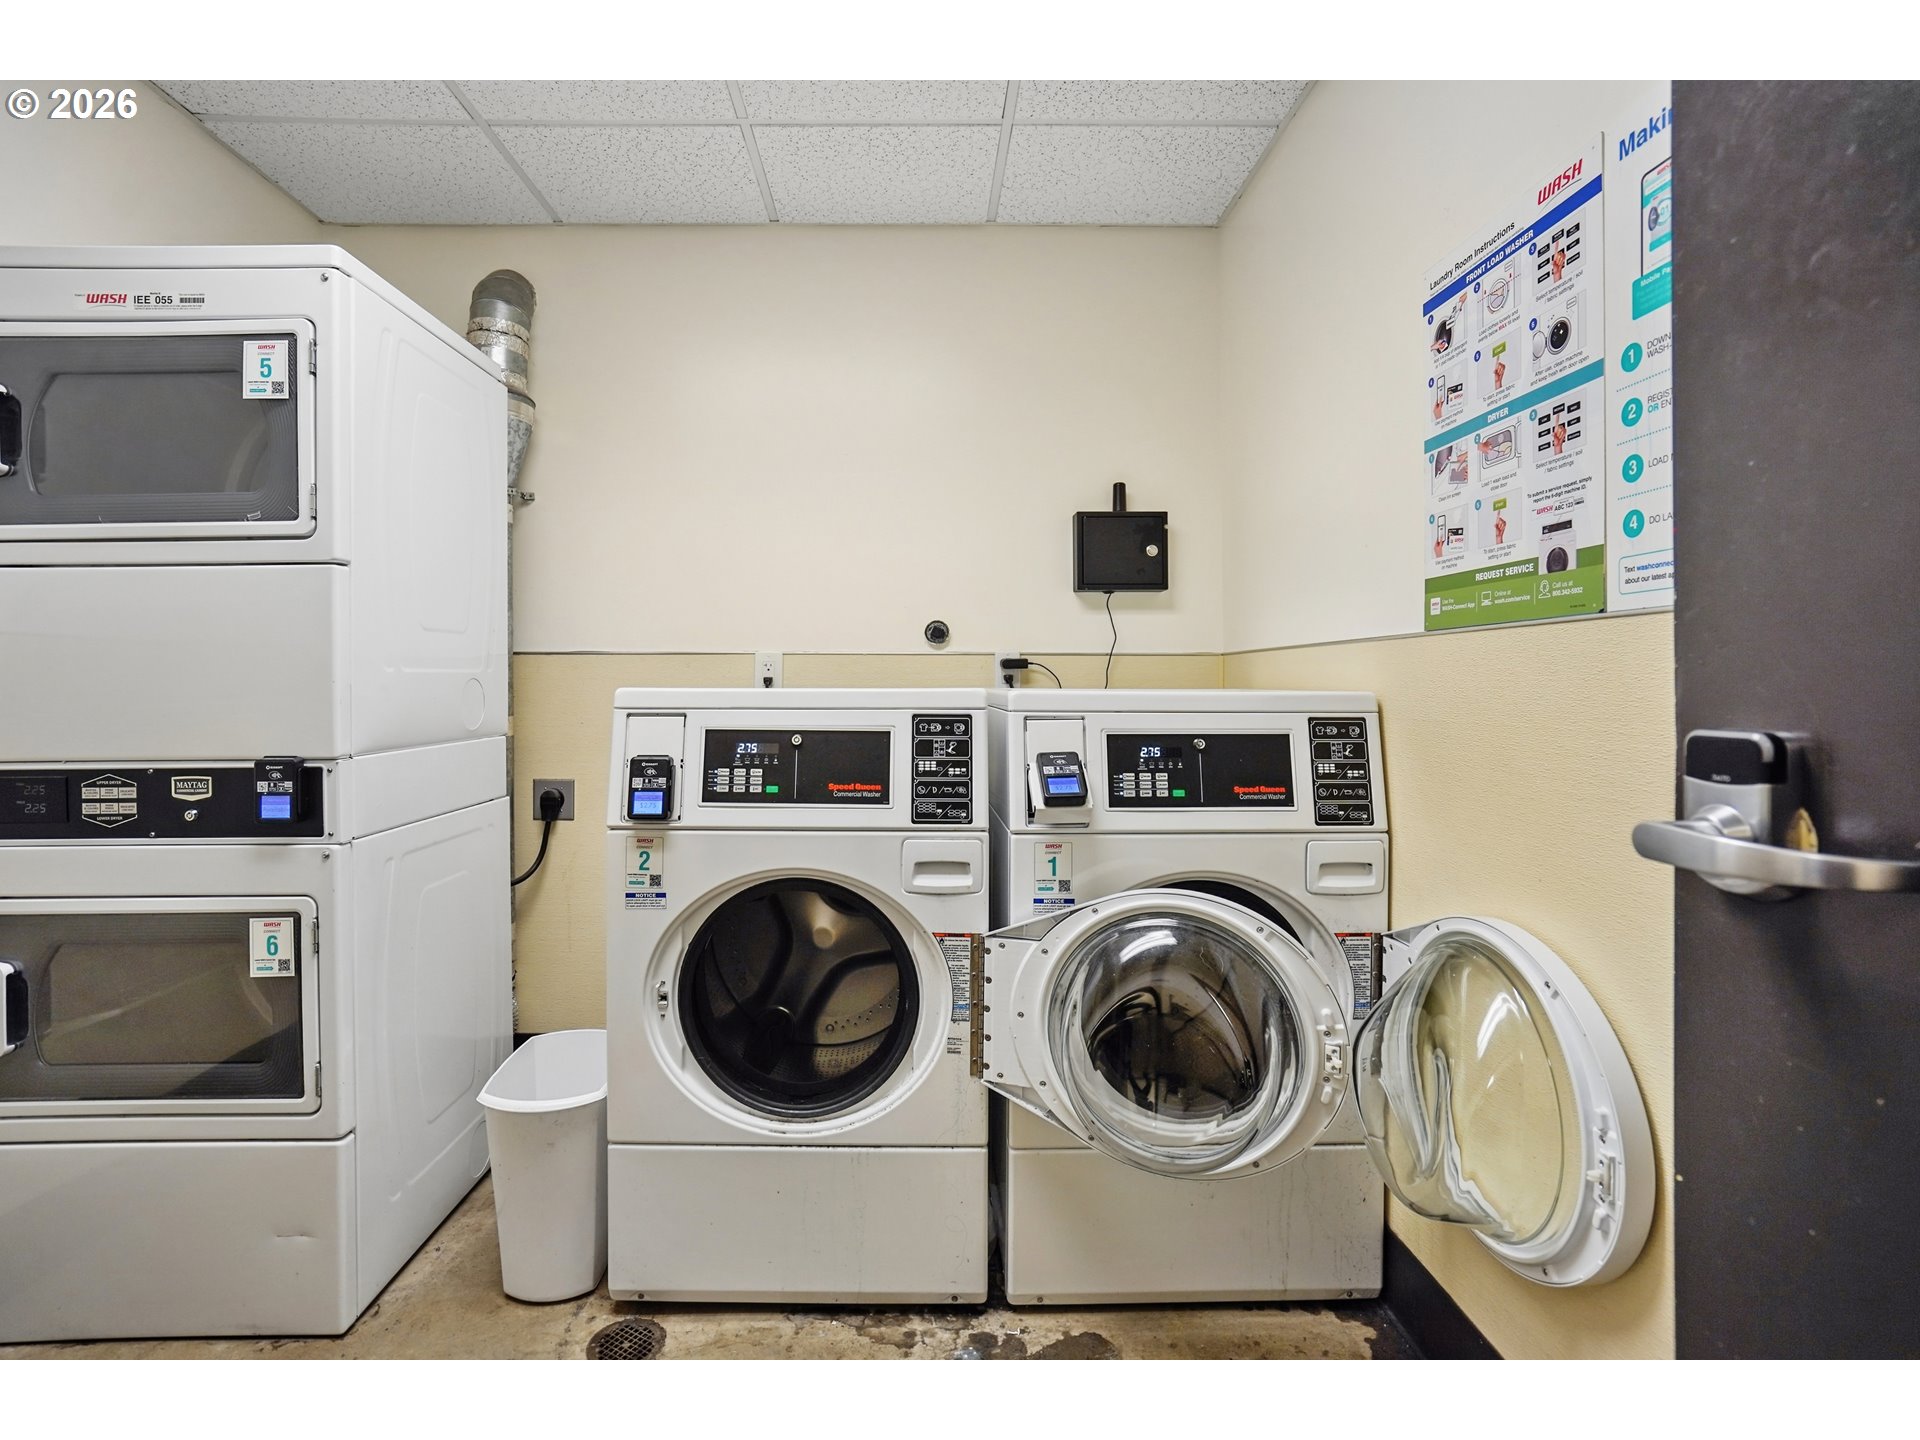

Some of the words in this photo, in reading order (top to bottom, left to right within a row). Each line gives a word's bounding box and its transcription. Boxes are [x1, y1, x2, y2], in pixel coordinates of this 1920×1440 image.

[1537, 159, 1582, 205] WASH
[1430, 268, 1453, 290] Laundry
[1455, 255, 1473, 271] Room
[1474, 222, 1514, 257] Instructions
[1466, 264, 1486, 284] FRONT
[1486, 252, 1504, 268] LOAD
[1505, 230, 1534, 255] WASHER
[86, 294, 127, 304] WASH
[134, 296, 151, 304] IEE
[155, 296, 173, 304] 055
[1647, 332, 1671, 349] DOWN
[260, 358, 272, 378] 5
[1487, 408, 1509, 423] DRYER
[1648, 403, 1659, 413] OR
[1535, 460, 1547, 469] Select
[1548, 453, 1572, 465] temperature
[1648, 455, 1669, 468] LOAD
[1578, 475, 1592, 484] simply
[1536, 504, 1553, 514] WASH
[1649, 515, 1660, 524] DO
[1476, 570, 1505, 581] REQUEST
[1505, 563, 1534, 576] SERVICE
[737, 743, 757, 753] 2.75
[1140, 747, 1160, 757] 2.75
[24, 785, 45, 794] 2.25
[25, 803, 46, 813] 2.25
[639, 851, 650, 870] 2
[1048, 857, 1056, 876] 1
[267, 935, 278, 956] 6
